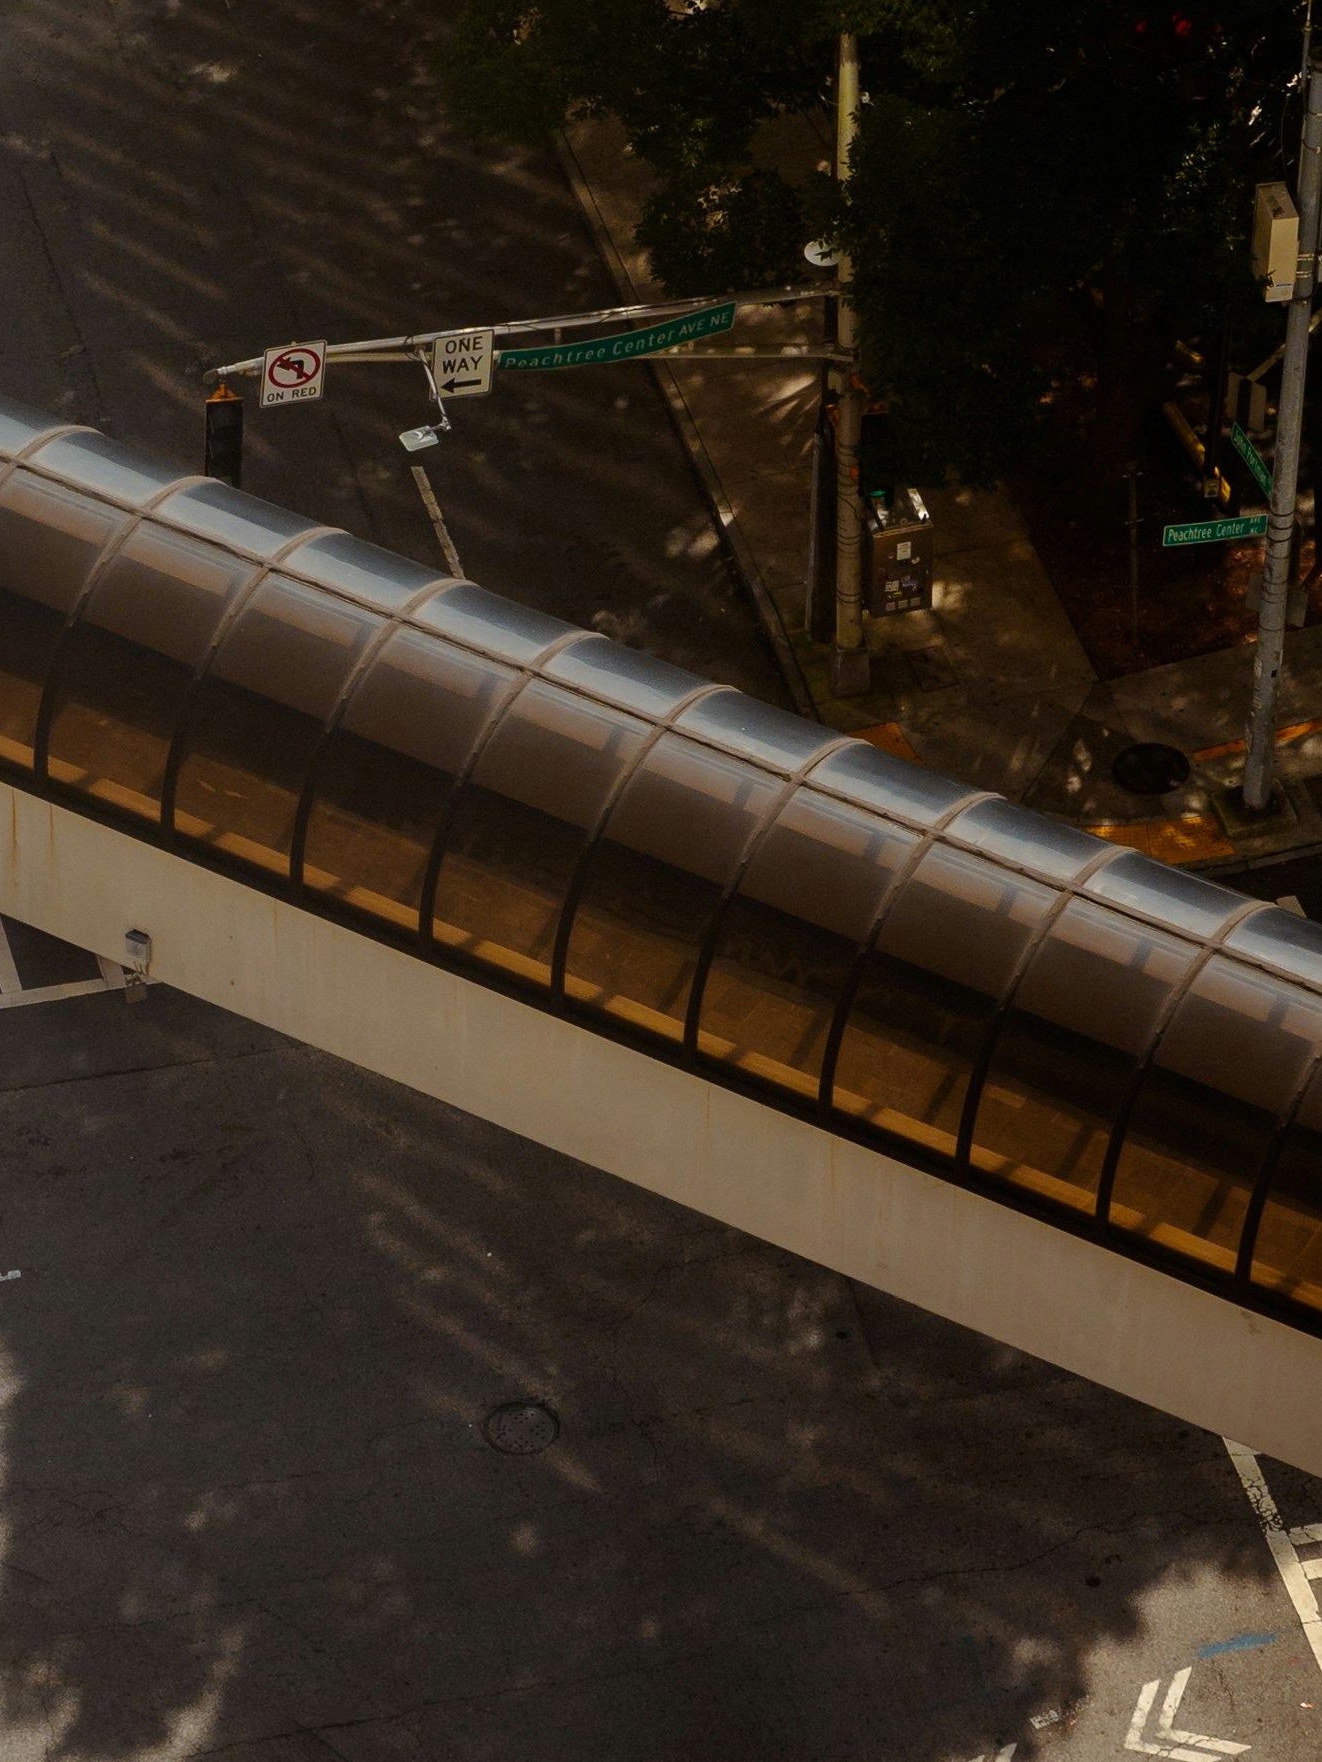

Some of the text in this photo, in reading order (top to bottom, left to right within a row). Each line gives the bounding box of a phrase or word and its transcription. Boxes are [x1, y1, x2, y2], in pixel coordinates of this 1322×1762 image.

[444, 336, 484, 355] ONE
[505, 310, 730, 370] Peachtree Center AVE NE
[442, 355, 484, 374] WAY
[266, 386, 317, 403] ON RED
[1168, 528, 1212, 542] Peachtree
[1216, 522, 1245, 536] Center
